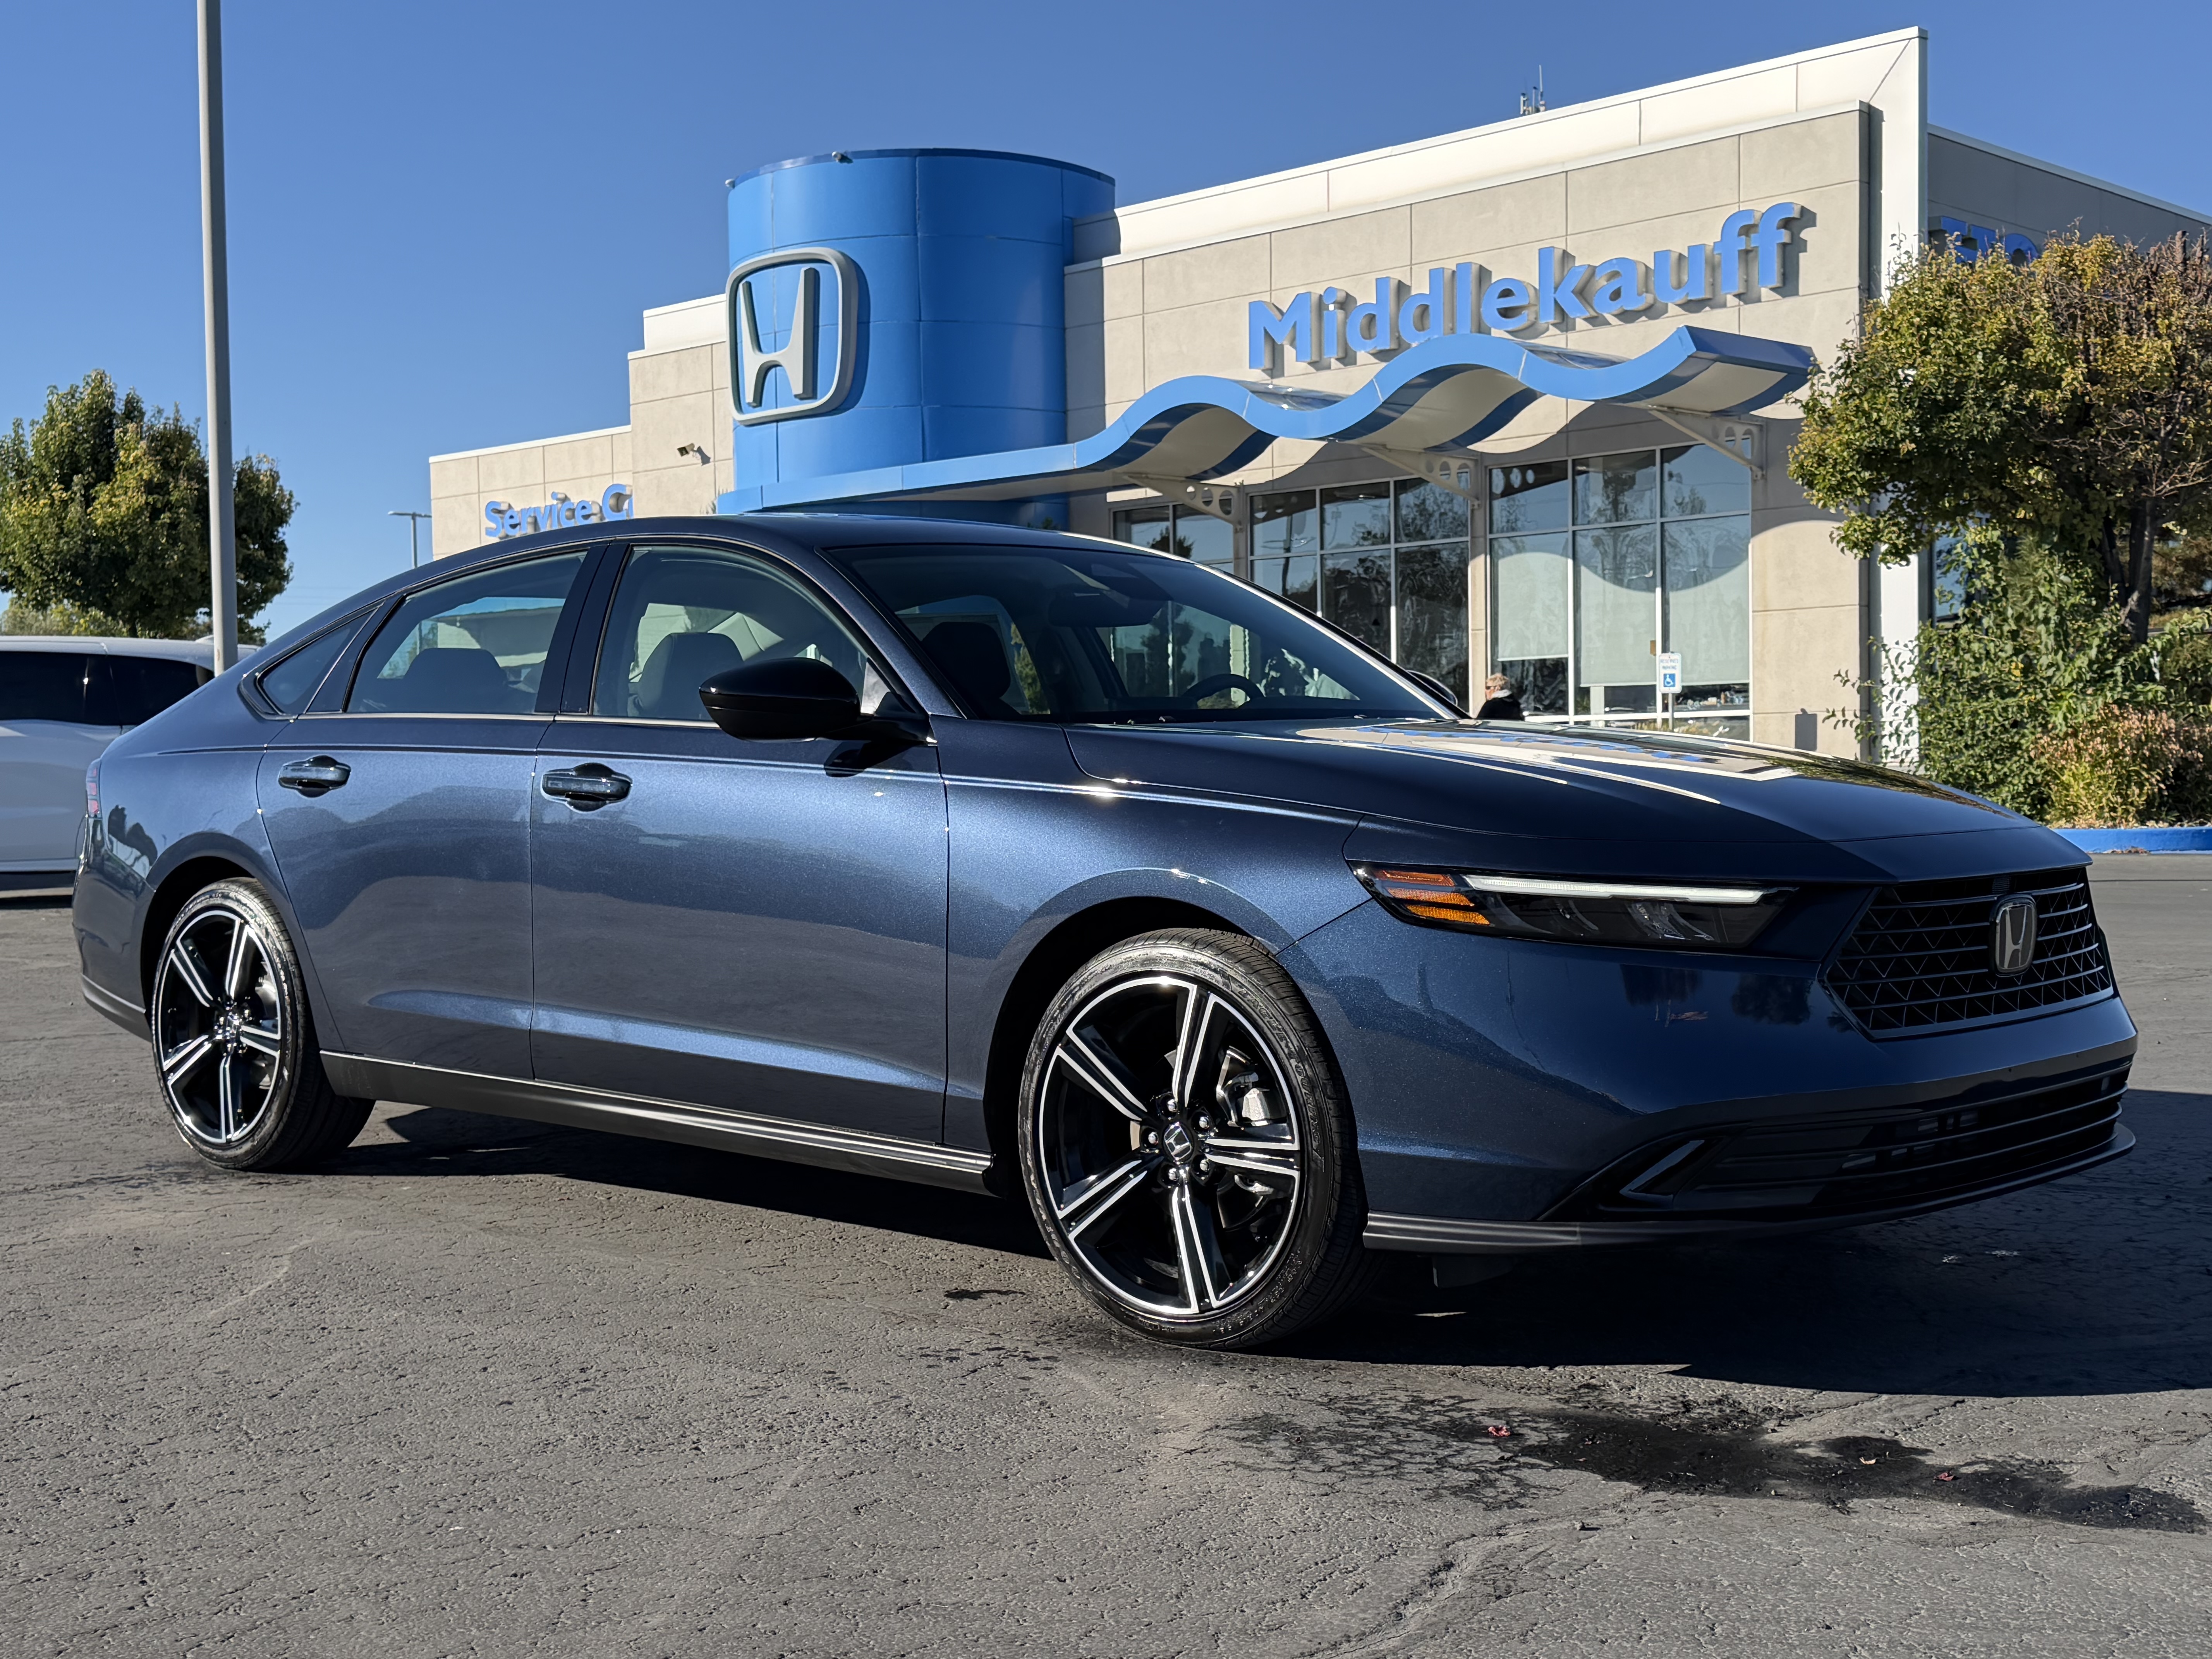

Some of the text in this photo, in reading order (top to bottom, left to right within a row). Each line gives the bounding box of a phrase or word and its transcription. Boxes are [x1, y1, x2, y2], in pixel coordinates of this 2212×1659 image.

[1248, 202, 1802, 371] Middlekauff
[485, 483, 634, 538] Service C
